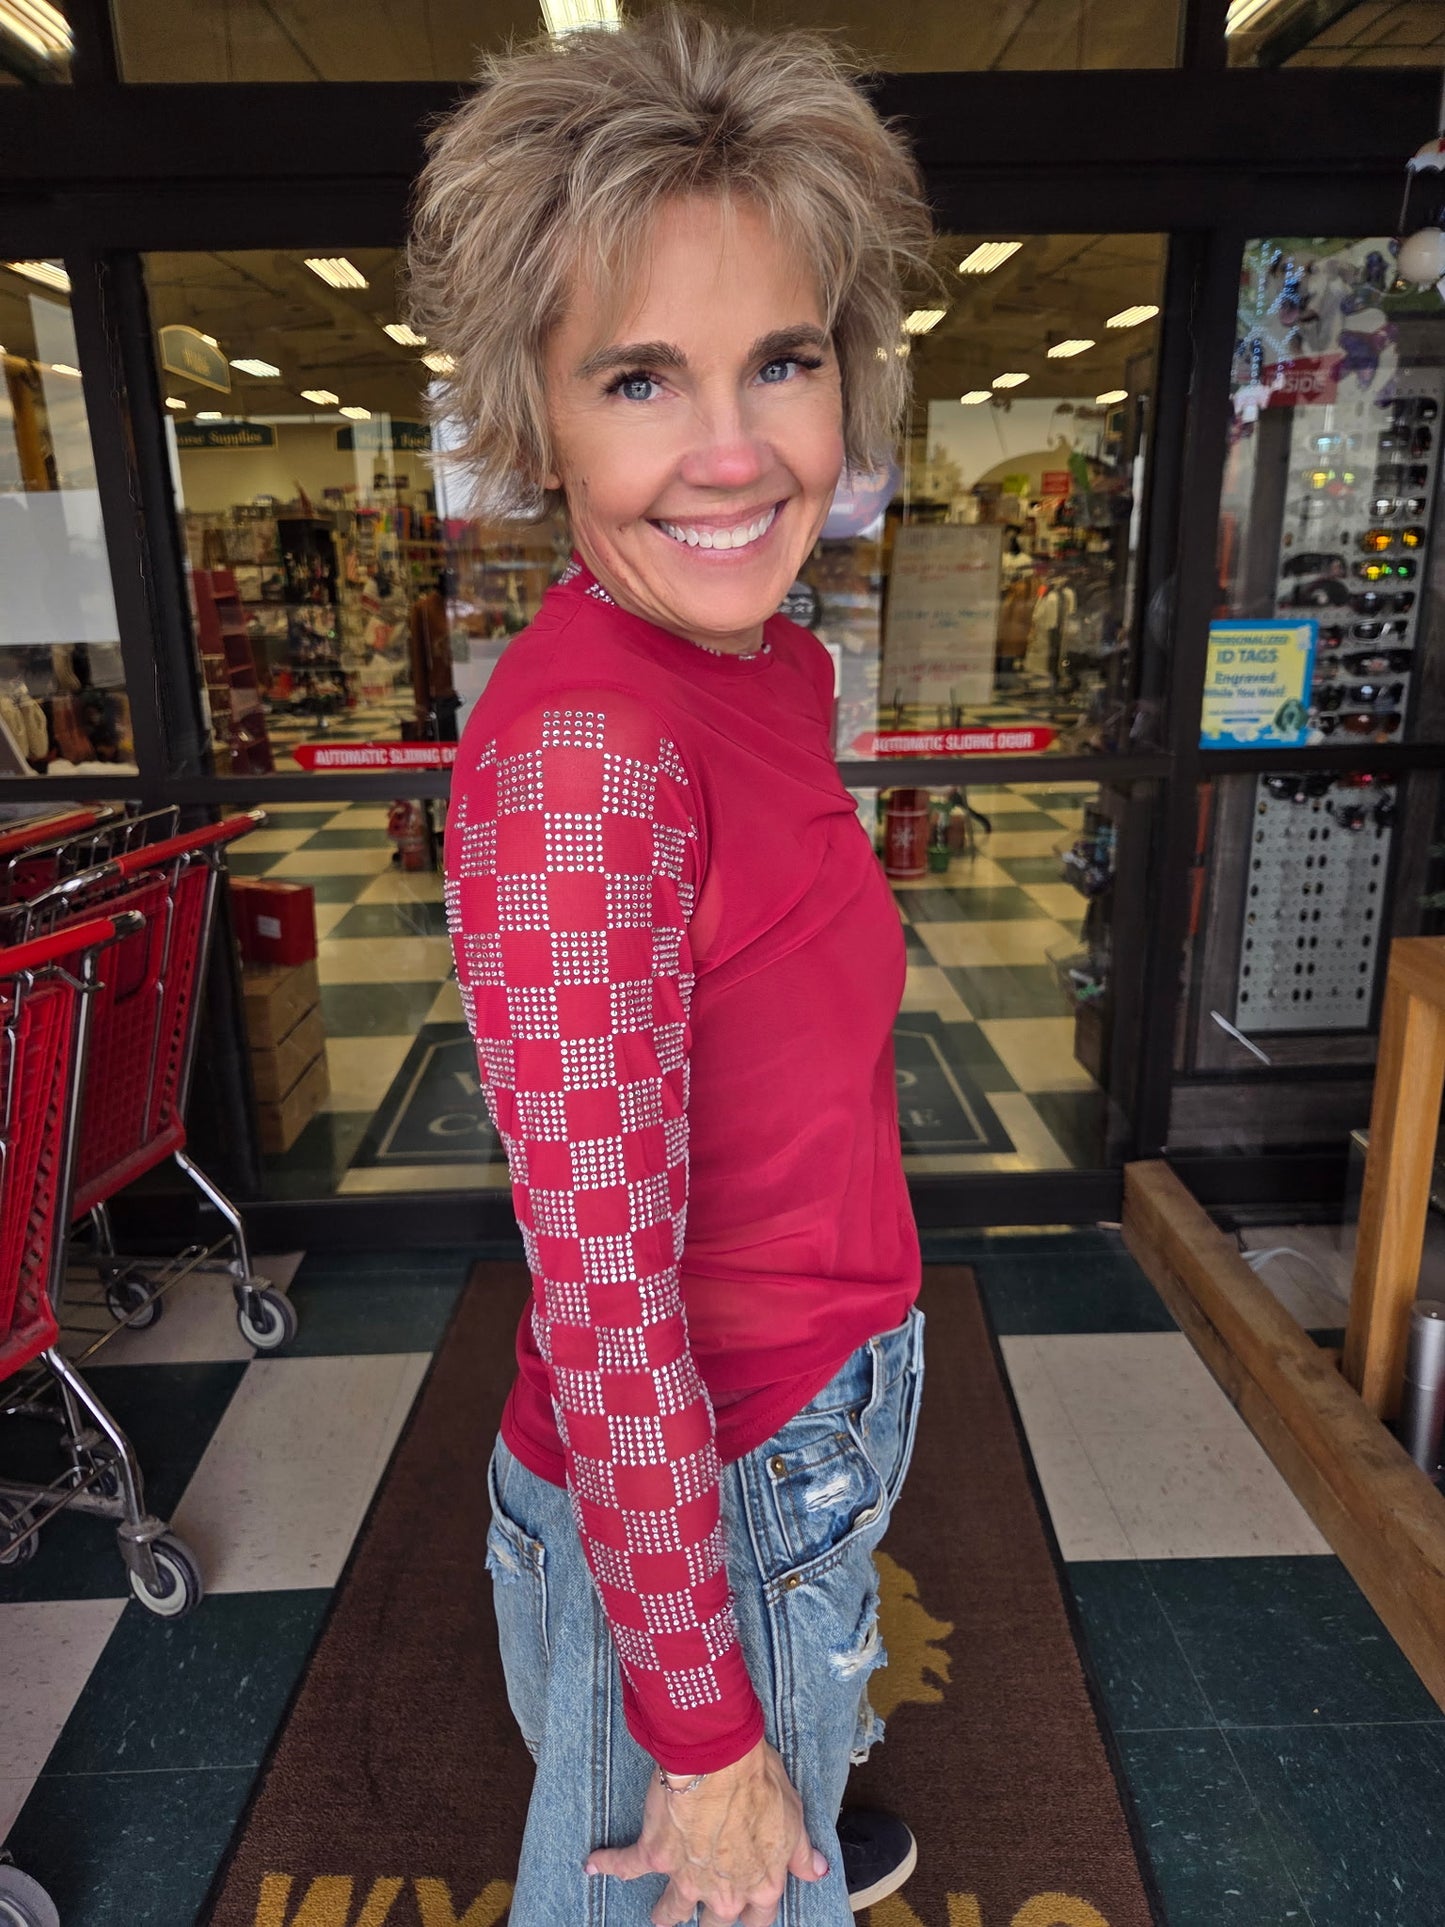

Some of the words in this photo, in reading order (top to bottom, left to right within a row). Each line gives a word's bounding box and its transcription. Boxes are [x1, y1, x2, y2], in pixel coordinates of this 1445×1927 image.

[1217, 650, 1234, 664] ID
[1239, 648, 1277, 663] TAGS
[1215, 671, 1276, 685] Engraved
[872, 735, 943, 752] AUTOMATIC
[945, 732, 993, 749] SLIDING
[998, 731, 1034, 748] DOOR
[315, 749, 387, 765] AUTOMATIC
[390, 748, 439, 764] SLIDING
